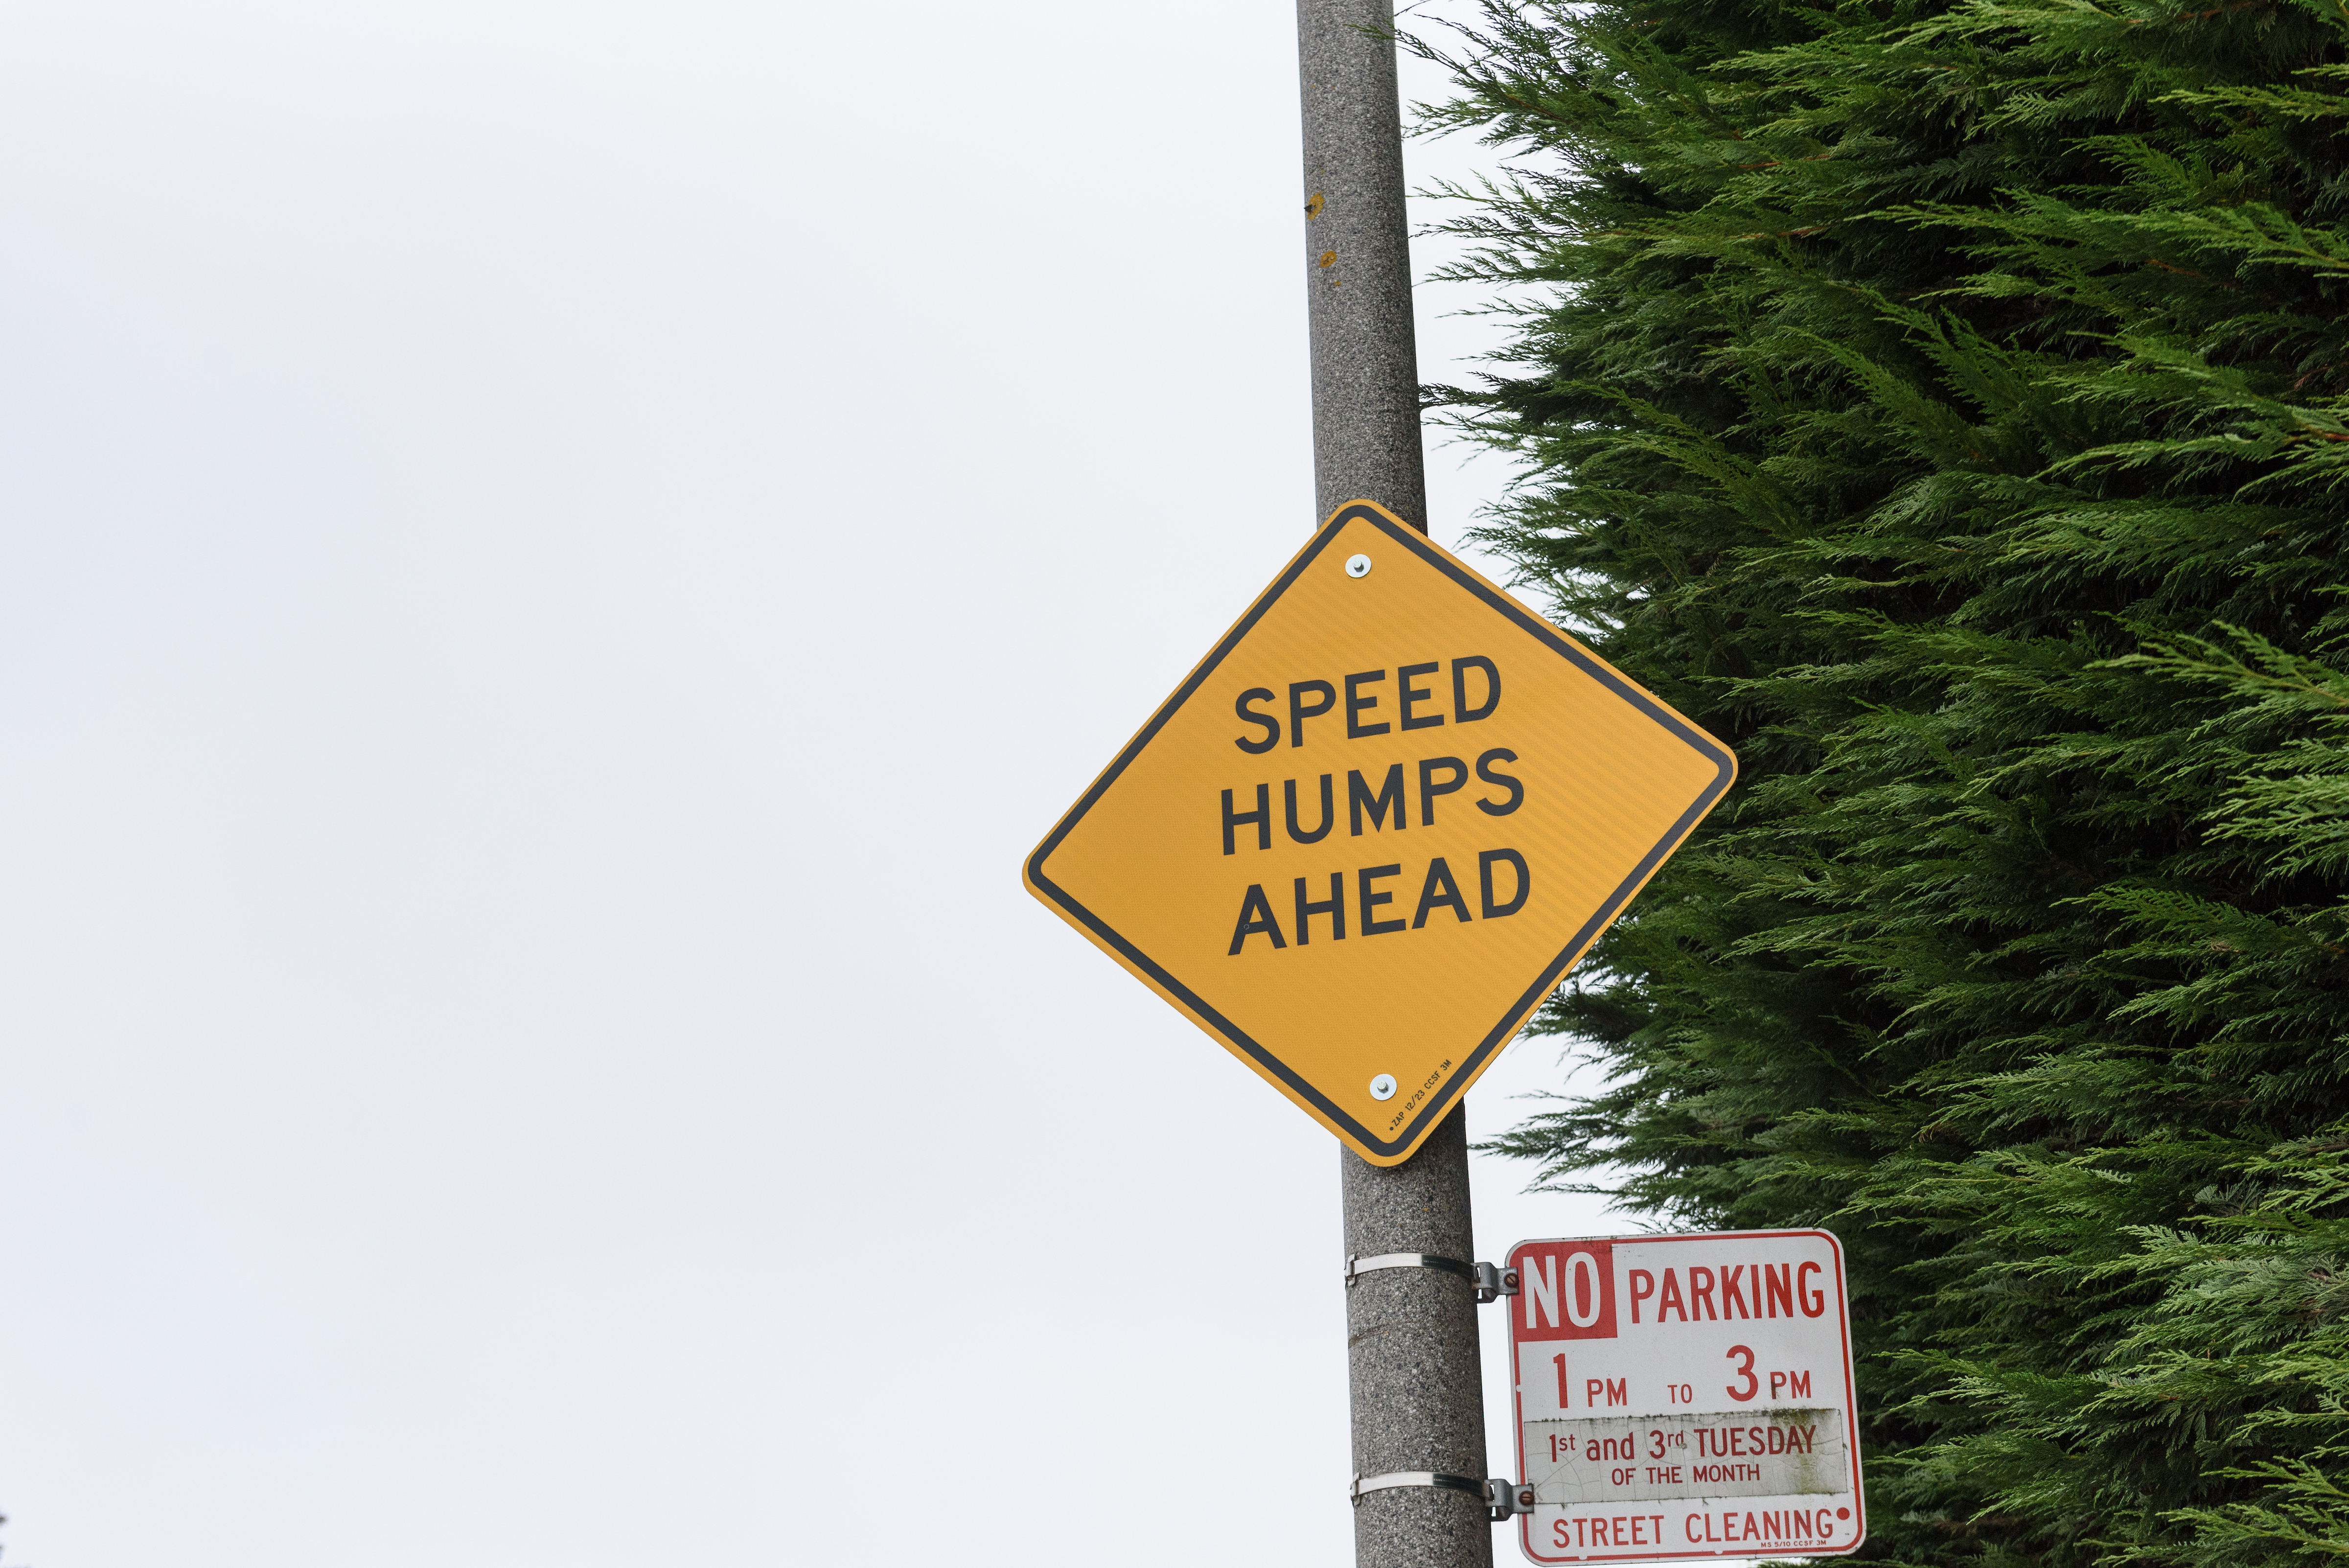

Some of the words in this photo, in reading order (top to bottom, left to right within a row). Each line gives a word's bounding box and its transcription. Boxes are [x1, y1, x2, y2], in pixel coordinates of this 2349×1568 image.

[1235, 655, 1501, 754] SPEED
[1221, 748, 1524, 855] HUMPS
[1228, 849, 1530, 956] AHEAD
[1391, 1111, 1405, 1127] ZAP
[1405, 1089, 1425, 1111] 12/23
[1424, 1070, 1440, 1089] CCSF
[1440, 1059, 1452, 1071] 3M
[1522, 1251, 1601, 1329] NO
[1629, 1261, 1825, 1324] PARKING
[1553, 1353, 1568, 1408] 1
[1587, 1378, 1627, 1407] PM
[1667, 1384, 1692, 1404] TO
[1726, 1345, 1758, 1402] 3
[1770, 1370, 1811, 1400] PM
[1549, 1434, 1576, 1462] 1st
[1587, 1431, 1635, 1461] and
[1649, 1430, 1684, 1459] 3rd
[1694, 1425, 1817, 1457] TUESDAY
[1612, 1468, 1636, 1485] OF
[1646, 1467, 1682, 1484] THE
[1693, 1464, 1760, 1482] MONTH
[1553, 1515, 1664, 1548] STREET
[1685, 1509, 1833, 1544] CLEANING
